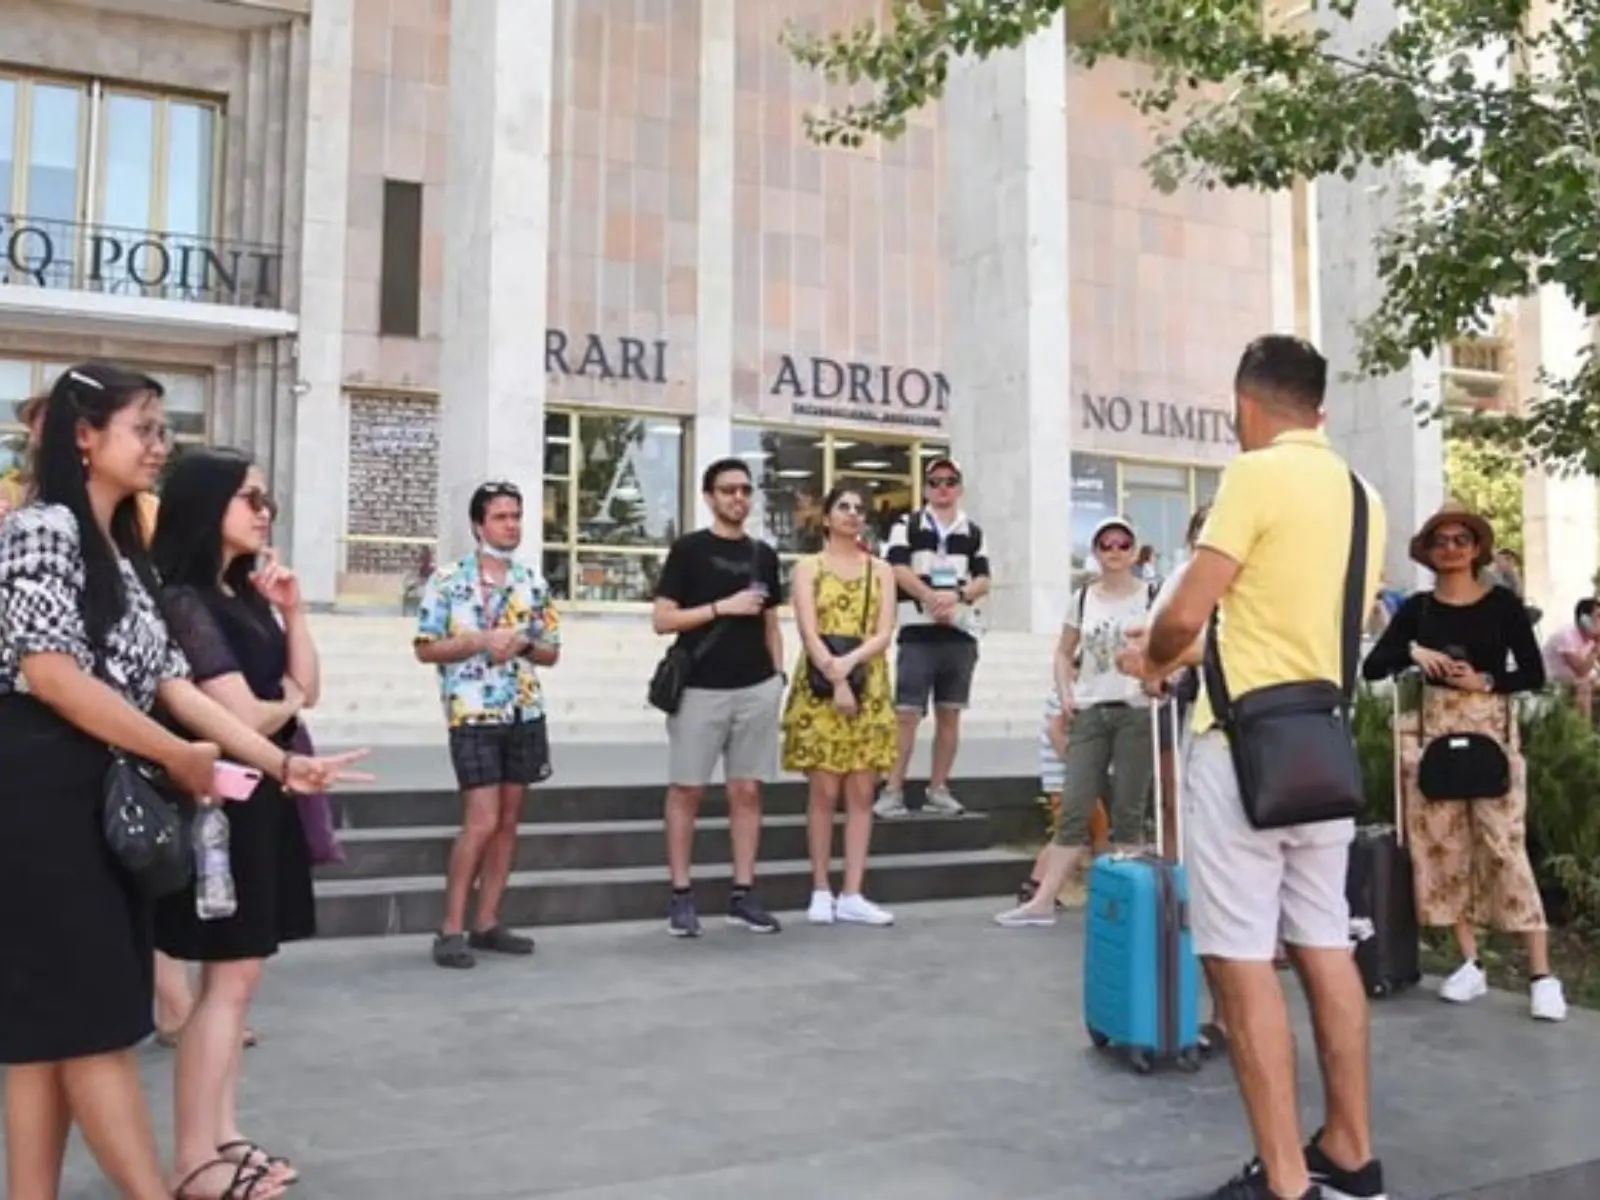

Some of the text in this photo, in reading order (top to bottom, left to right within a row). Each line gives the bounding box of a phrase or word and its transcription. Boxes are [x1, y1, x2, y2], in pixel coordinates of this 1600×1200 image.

[90, 235, 283, 296] POINT
[545, 328, 667, 384] RARI
[1082, 393, 1133, 433] NO
